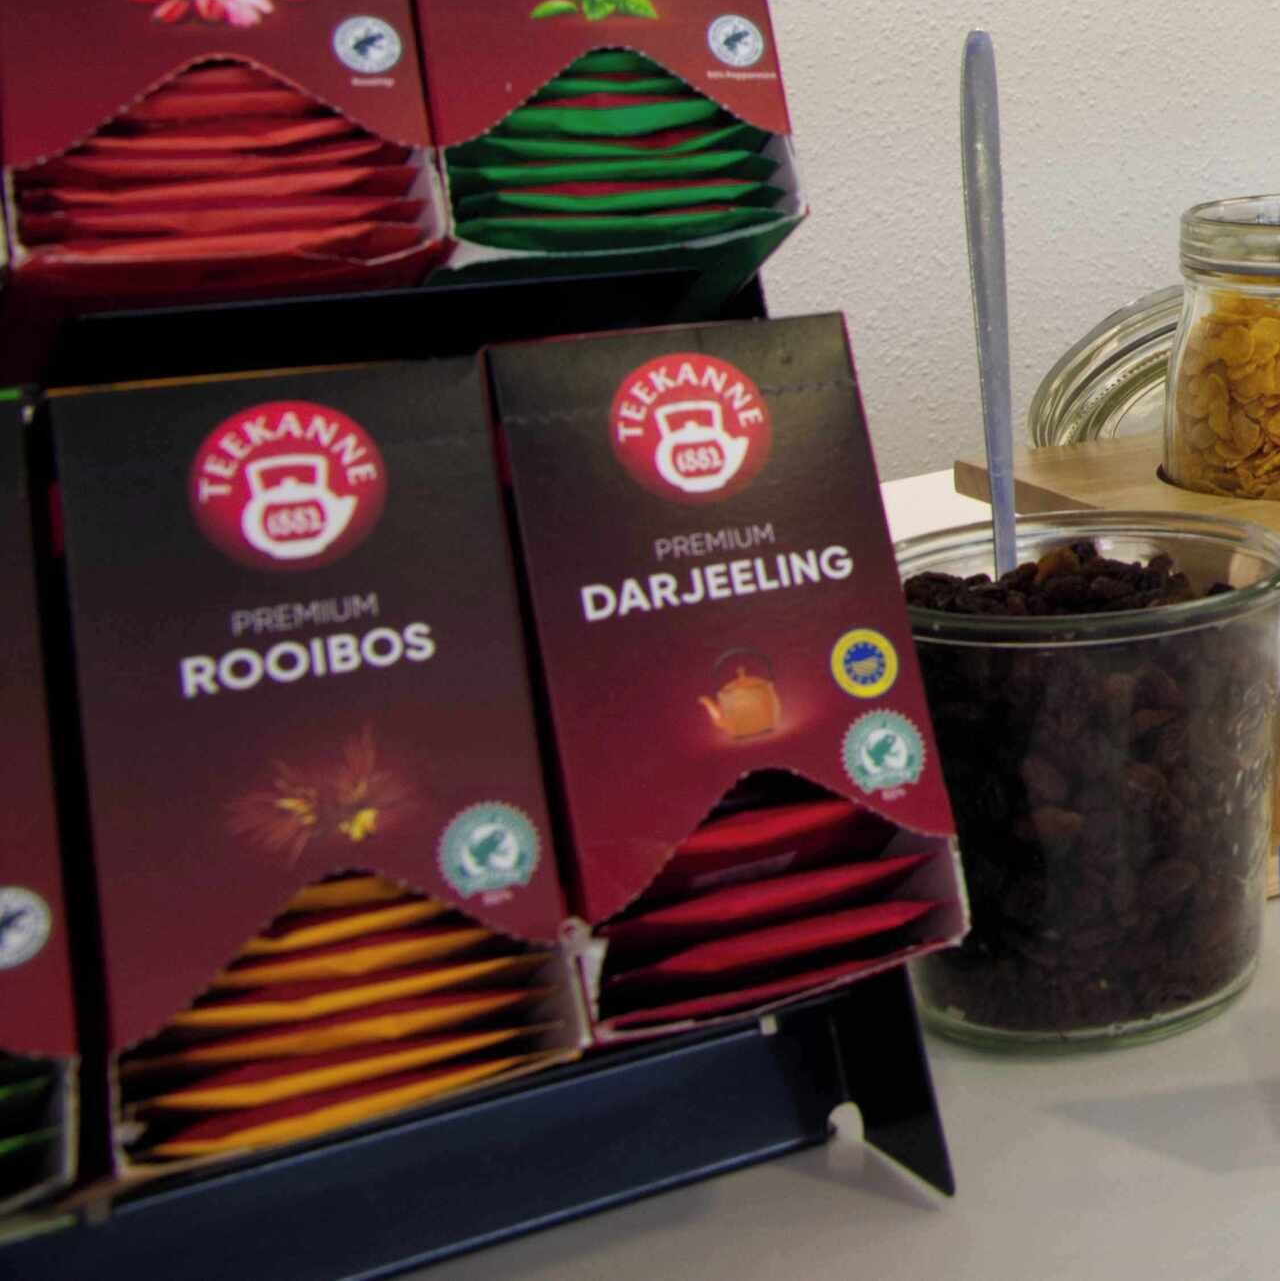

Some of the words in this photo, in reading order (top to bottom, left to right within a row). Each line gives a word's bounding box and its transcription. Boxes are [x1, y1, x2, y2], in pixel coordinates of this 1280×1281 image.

[617, 361, 764, 444] TEEKANNE
[198, 410, 378, 504] TEEKANNE
[653, 522, 776, 562] PREMIUM
[231, 592, 380, 637] PREMIUM
[580, 545, 854, 623] DARJEELING
[180, 621, 436, 699] ROOIBOS
